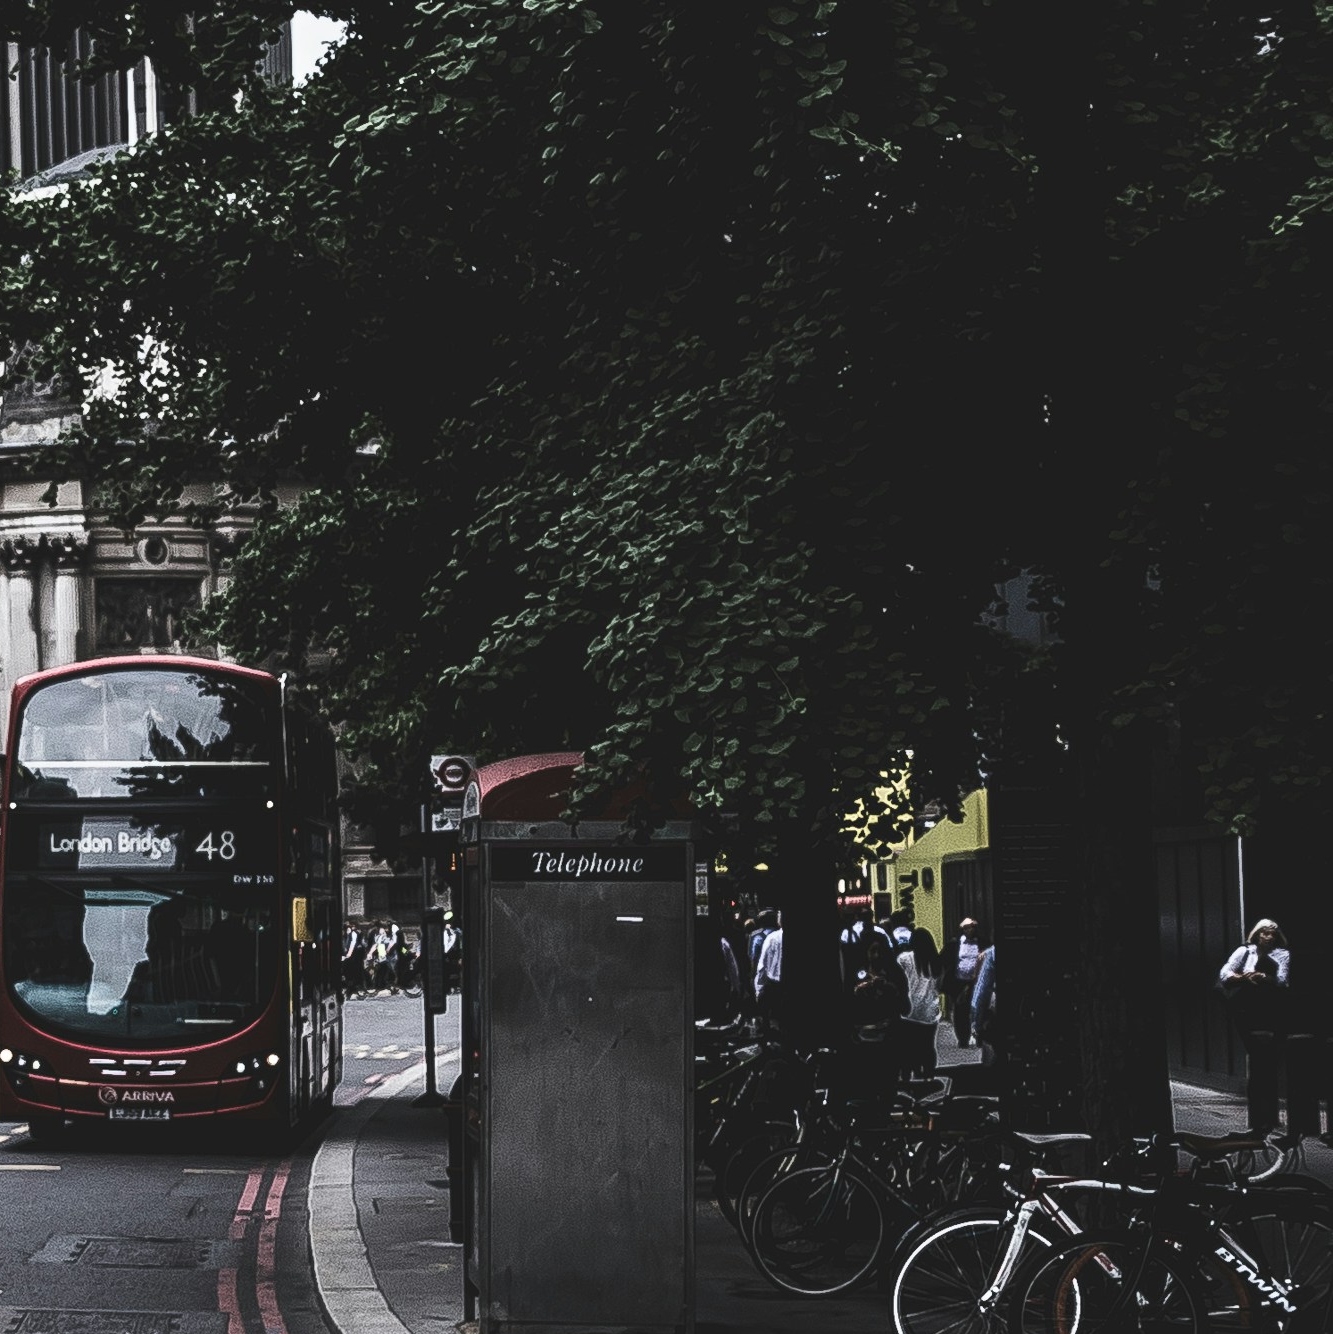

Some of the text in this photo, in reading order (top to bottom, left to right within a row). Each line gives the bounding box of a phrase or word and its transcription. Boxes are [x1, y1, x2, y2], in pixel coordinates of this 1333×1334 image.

[50, 830, 237, 861] London Bridge 48
[532, 851, 644, 878] Telephone
[121, 1090, 175, 1102] ARRIVA
